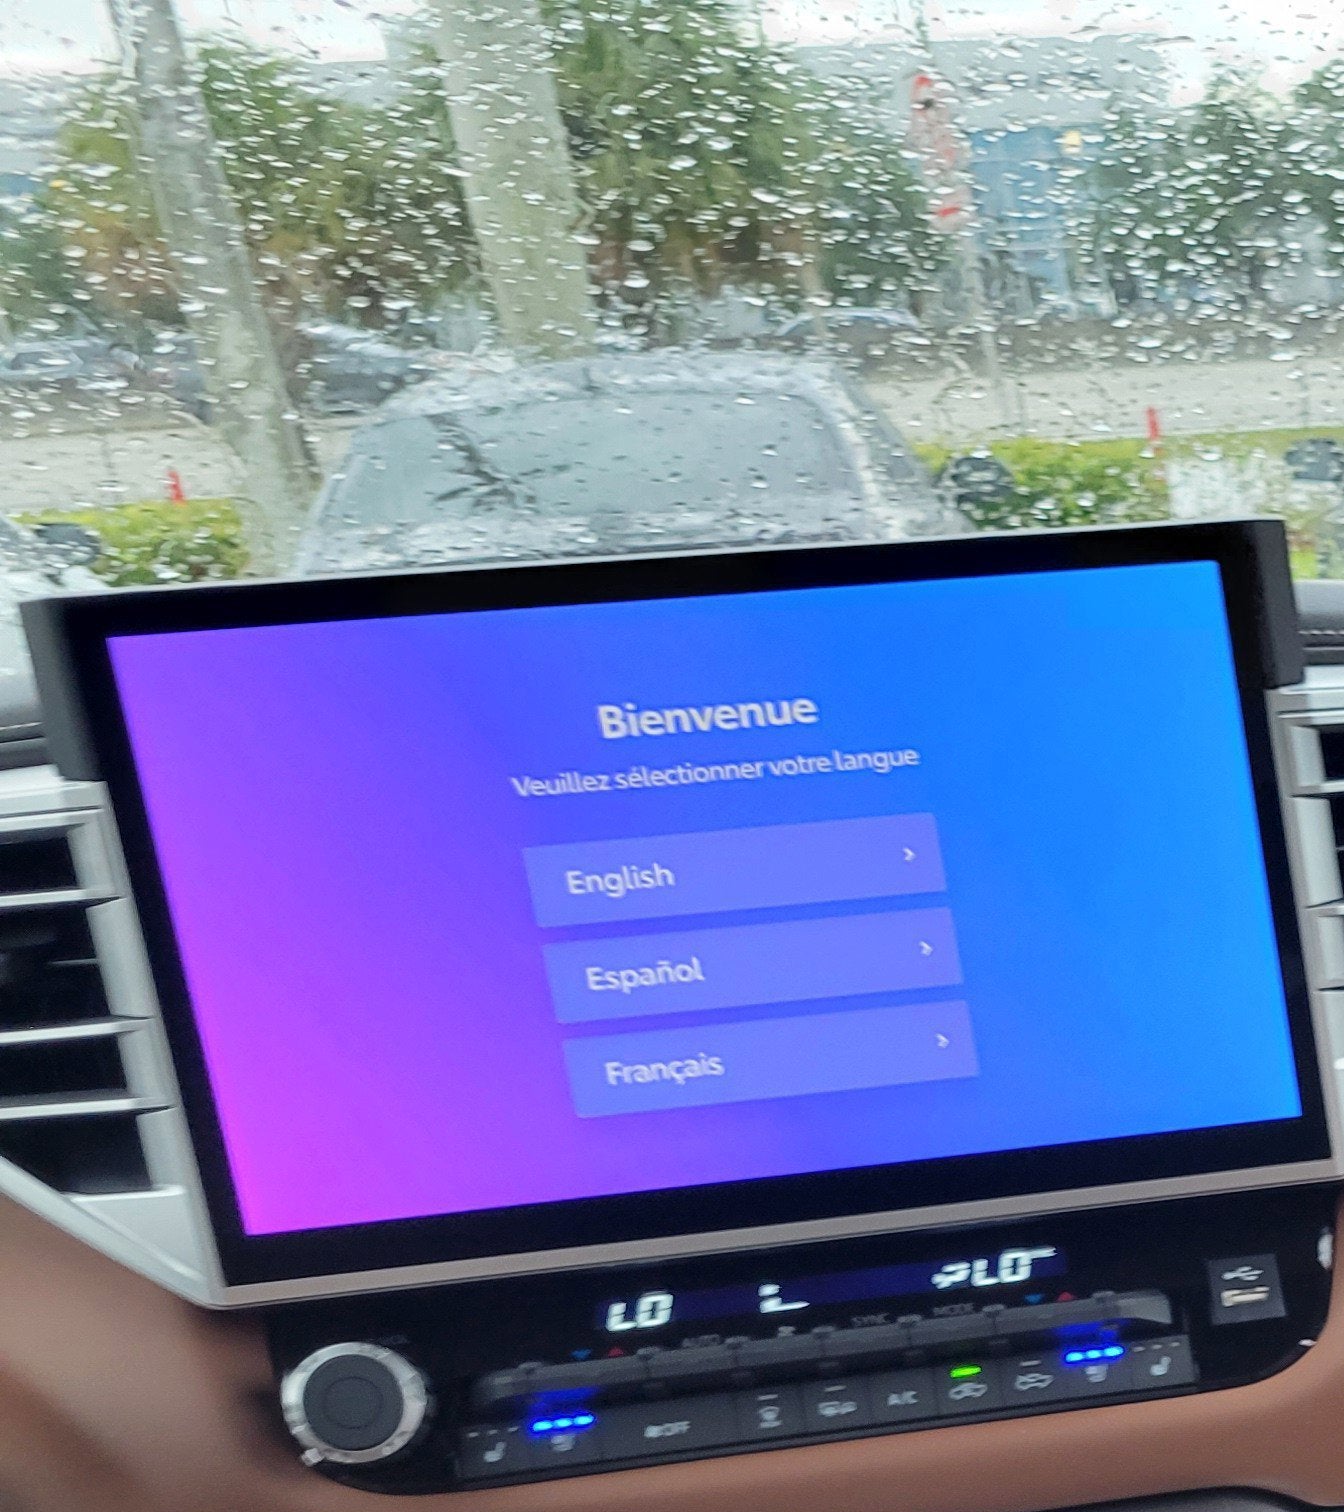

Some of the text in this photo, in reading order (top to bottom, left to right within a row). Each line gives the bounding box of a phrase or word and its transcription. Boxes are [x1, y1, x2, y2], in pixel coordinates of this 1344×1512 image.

[597, 698, 820, 739] Bienvenue
[510, 748, 921, 798] Veuillez sélectionner votre langue
[566, 862, 676, 898] English
[585, 957, 706, 995] Español
[604, 1051, 725, 1086] Français
